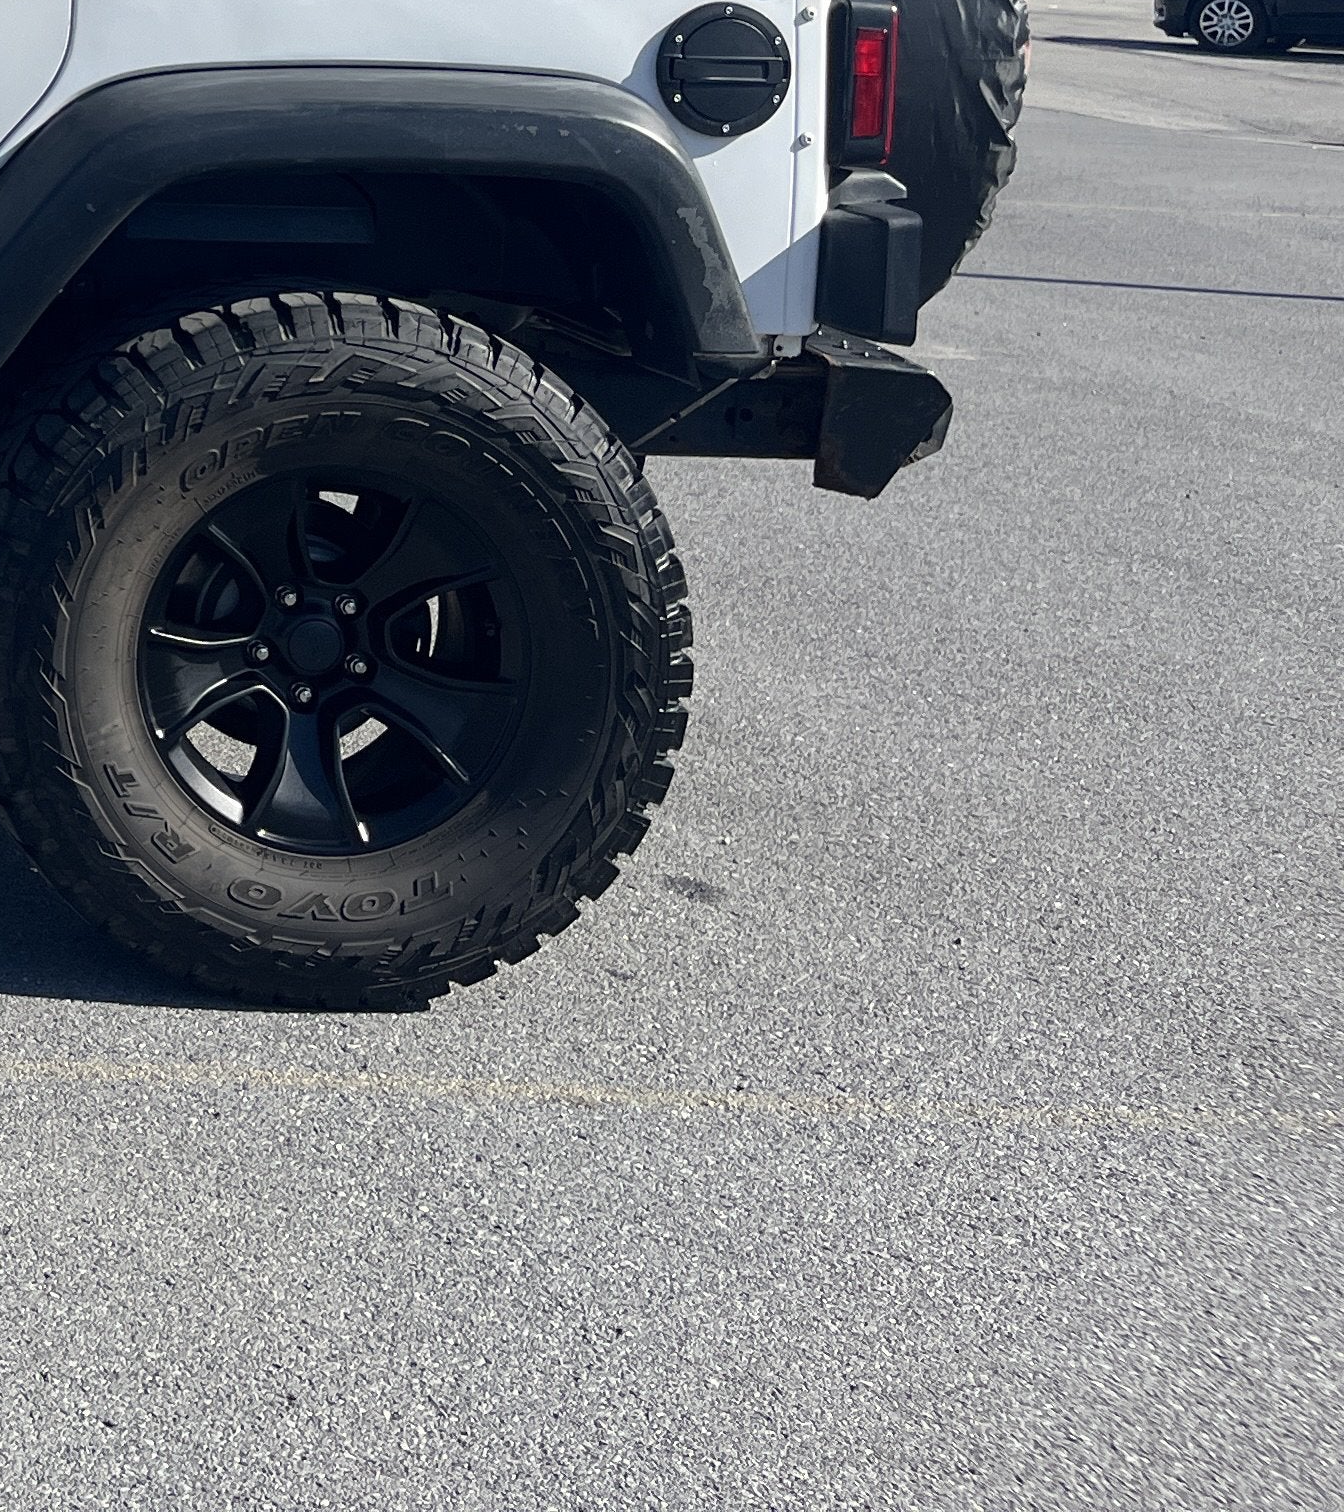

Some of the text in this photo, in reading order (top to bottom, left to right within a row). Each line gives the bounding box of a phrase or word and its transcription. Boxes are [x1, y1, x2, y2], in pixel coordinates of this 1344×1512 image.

[178, 411, 361, 494] OPEN
[102, 760, 198, 865] R/T
[227, 871, 455, 921] TOYO
